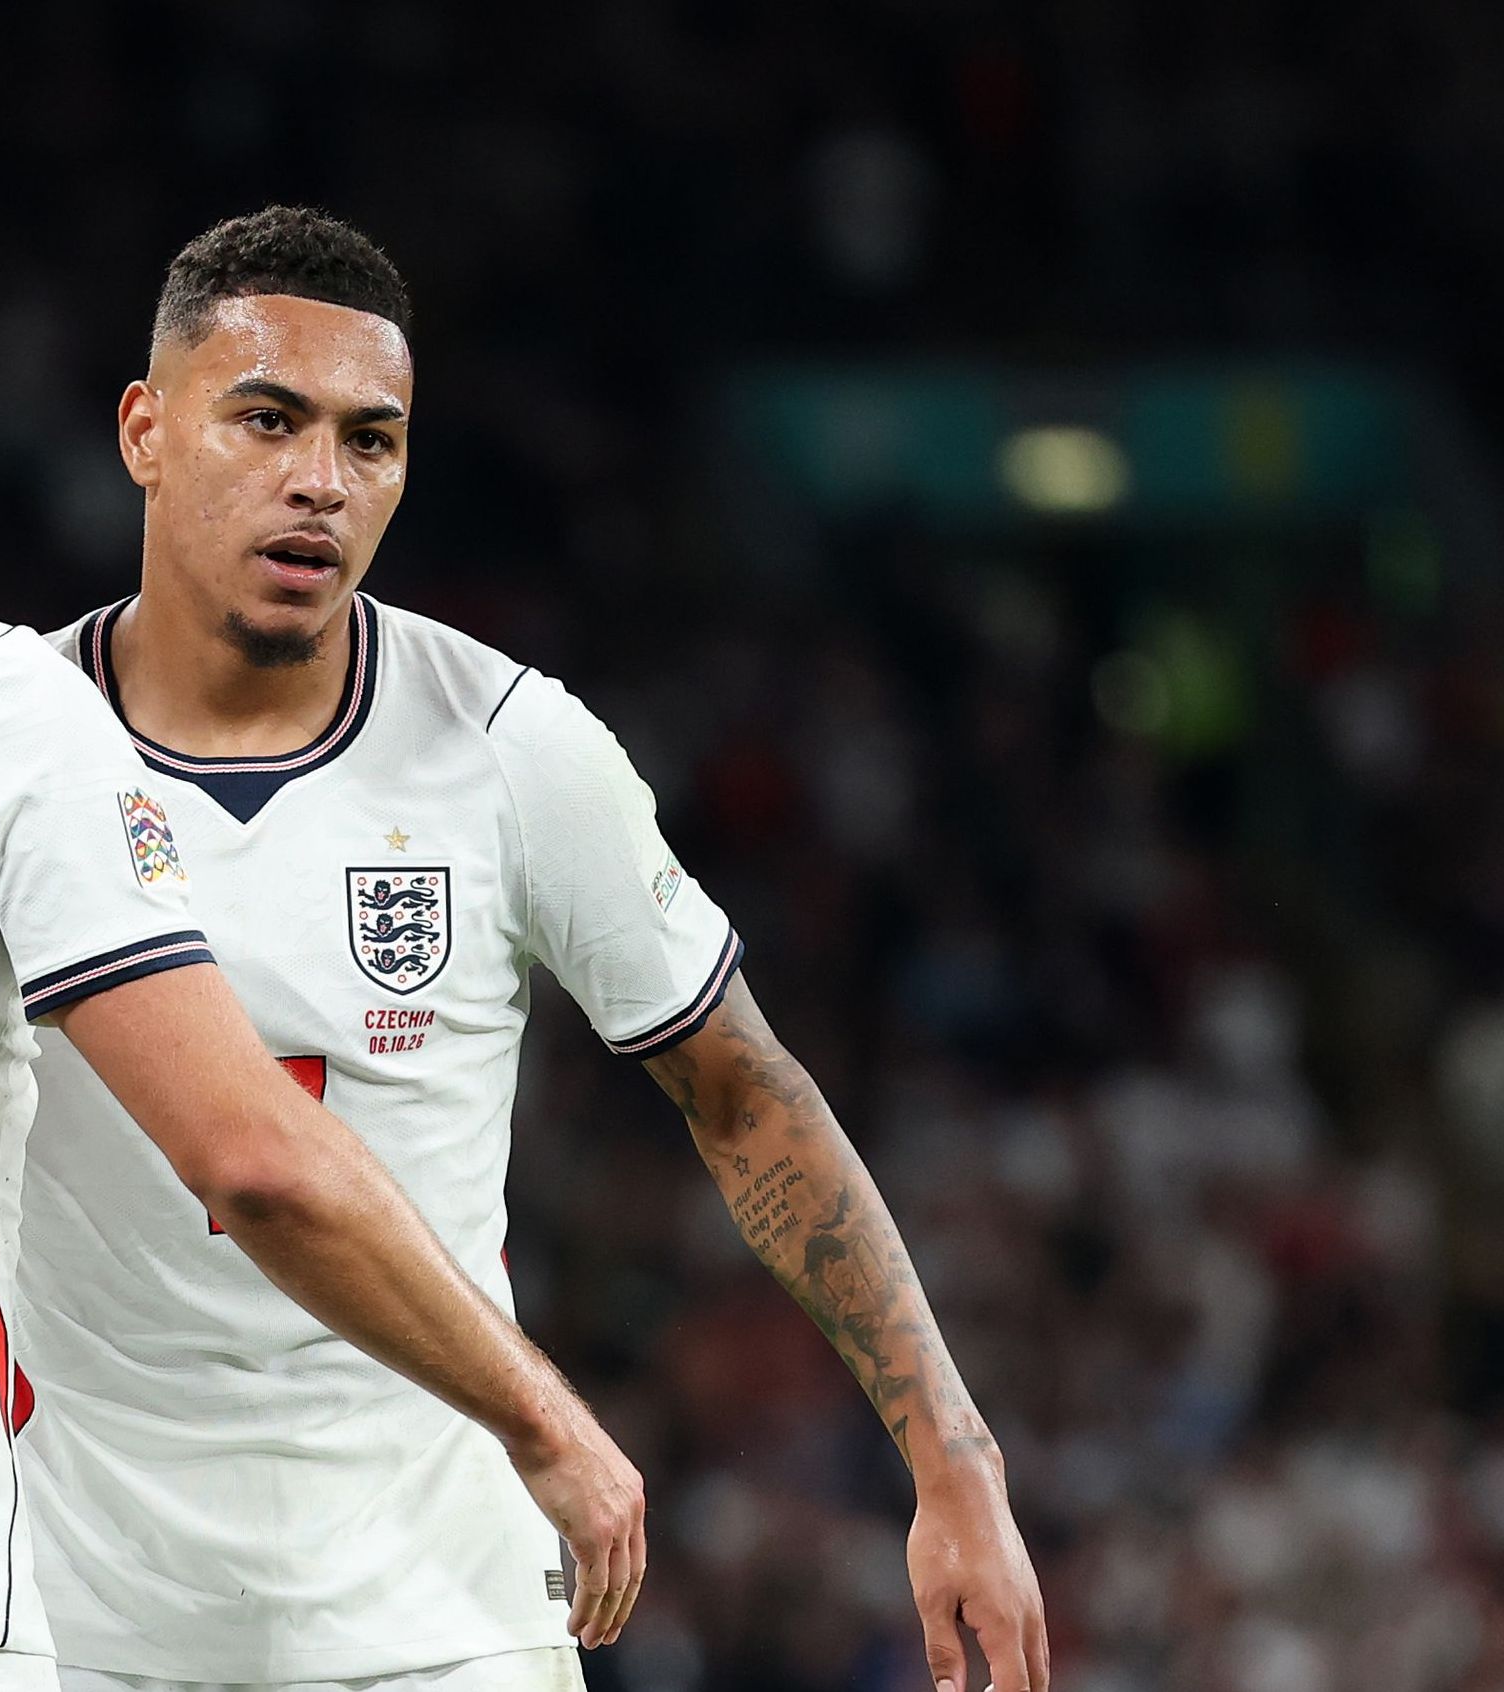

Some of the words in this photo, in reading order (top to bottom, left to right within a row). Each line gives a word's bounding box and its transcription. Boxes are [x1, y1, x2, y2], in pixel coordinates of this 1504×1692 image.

[364, 1009, 435, 1029] CZECHIA
[369, 1032, 425, 1054] 06.10.26
[754, 1155, 793, 1192] dreams
[752, 1188, 776, 1215] scare
[779, 1170, 803, 1195] you
[749, 1214, 770, 1239] they
[771, 1199, 789, 1219] are
